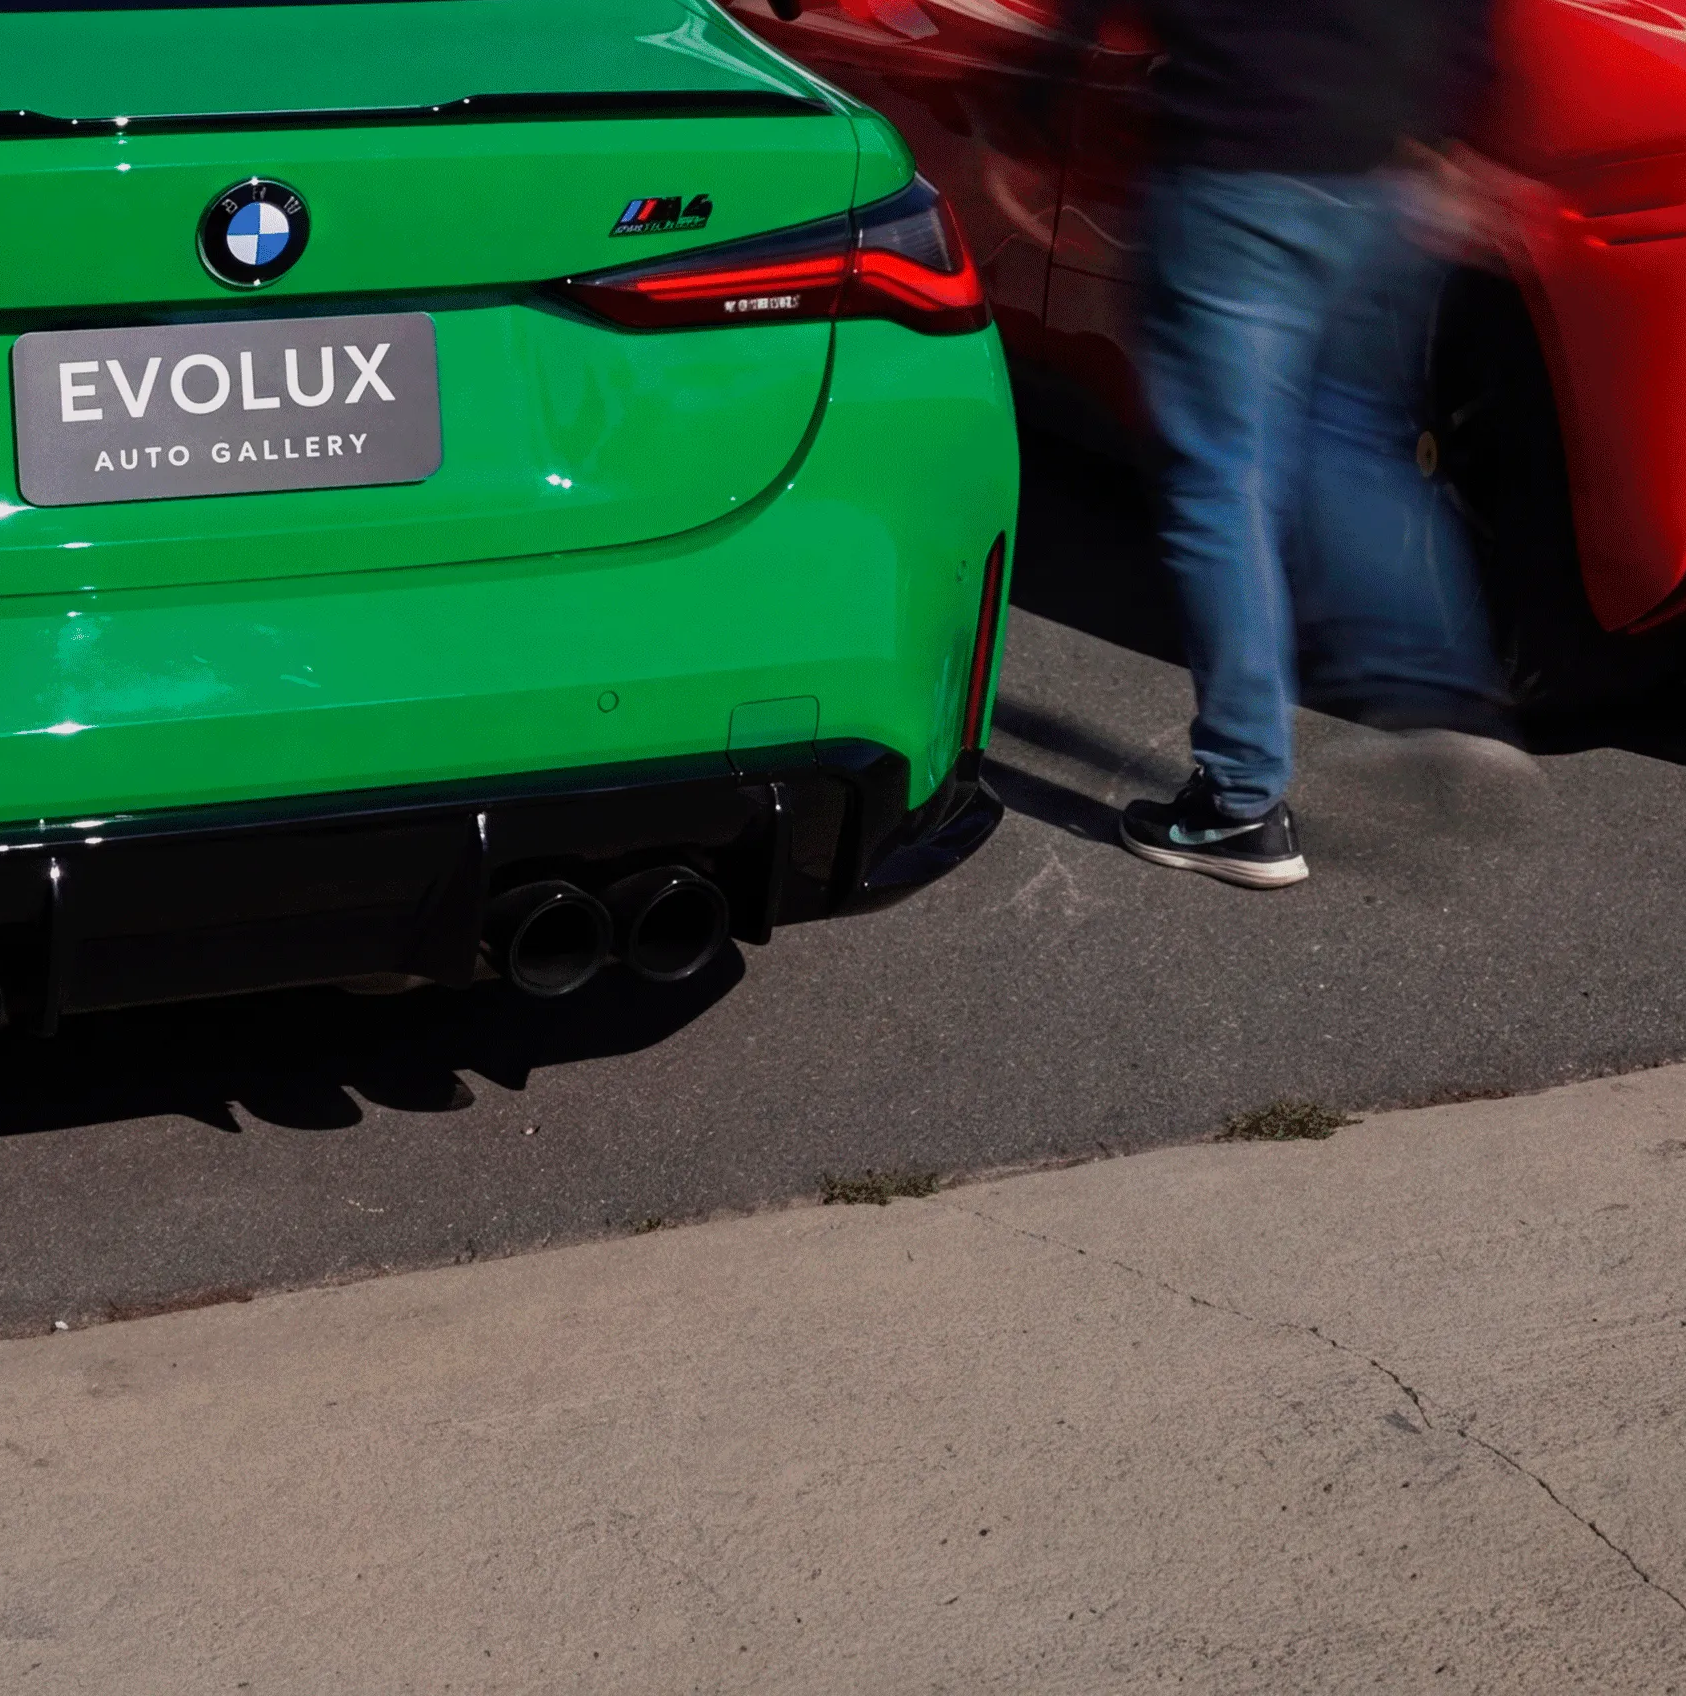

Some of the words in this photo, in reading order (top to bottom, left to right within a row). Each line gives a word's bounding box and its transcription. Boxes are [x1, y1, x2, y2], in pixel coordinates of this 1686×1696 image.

[58, 343, 396, 423] EVOLUX
[94, 445, 190, 472] AUTO
[211, 433, 367, 464] GALLERY
